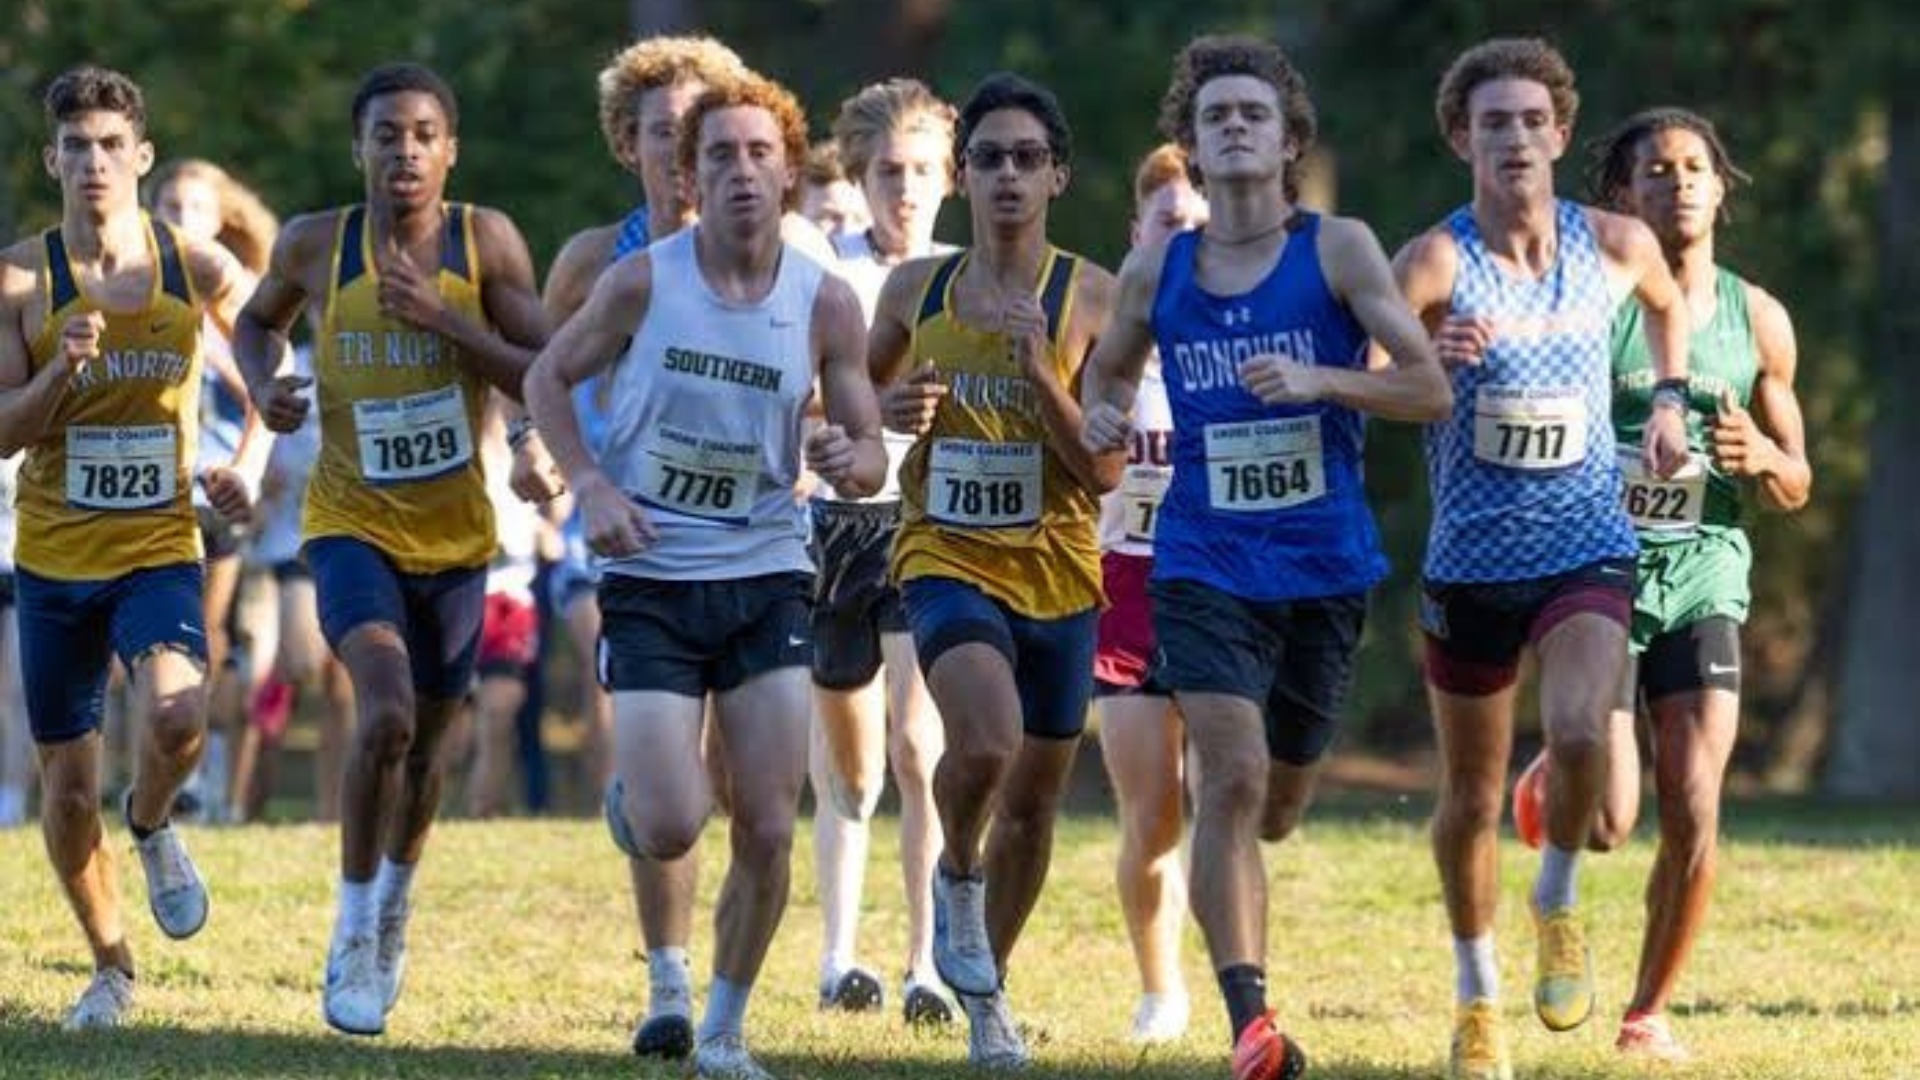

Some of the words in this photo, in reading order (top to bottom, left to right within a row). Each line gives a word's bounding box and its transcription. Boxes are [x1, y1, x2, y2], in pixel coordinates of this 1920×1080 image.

[105, 349, 188, 386] NORTH
[338, 331, 373, 366] TR
[663, 346, 782, 393] SOUTHERN
[374, 428, 459, 471] 7829
[1497, 424, 1566, 460] 7717
[81, 463, 161, 498] 7823
[659, 464, 737, 510] 7776
[945, 478, 1023, 516] 7818
[1221, 458, 1309, 501] 7664
